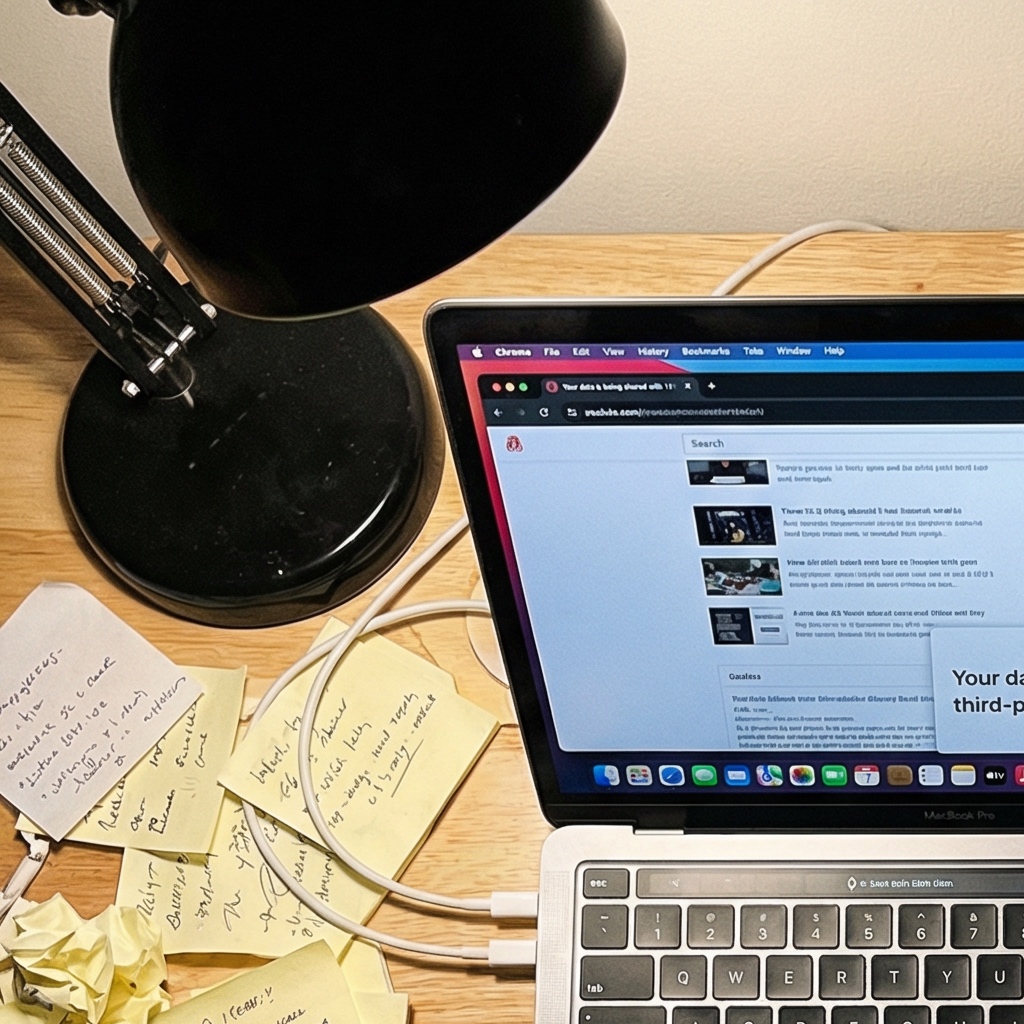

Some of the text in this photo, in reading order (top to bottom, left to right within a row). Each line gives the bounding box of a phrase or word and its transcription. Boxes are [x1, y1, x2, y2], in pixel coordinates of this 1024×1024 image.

[602, 348, 625, 356] View
[637, 347, 669, 358] History
[681, 347, 730, 356] Bookmarks
[776, 346, 812, 355] Window
[824, 346, 845, 356] Help
[692, 439, 724, 447] Search
[953, 670, 1000, 685] Your
[978, 811, 995, 820] Pro
[655, 929, 659, 939] 1
[707, 929, 714, 939] 2
[812, 928, 819, 938] 4
[865, 928, 873, 939] 5
[917, 928, 925, 939] 6
[970, 928, 977, 939] 7
[678, 971, 688, 984] Q
[729, 972, 743, 983] W
[785, 972, 793, 983] E
[838, 971, 846, 983] R
[890, 971, 899, 983] T
[943, 971, 951, 983] Y
[995, 971, 1005, 983] U
